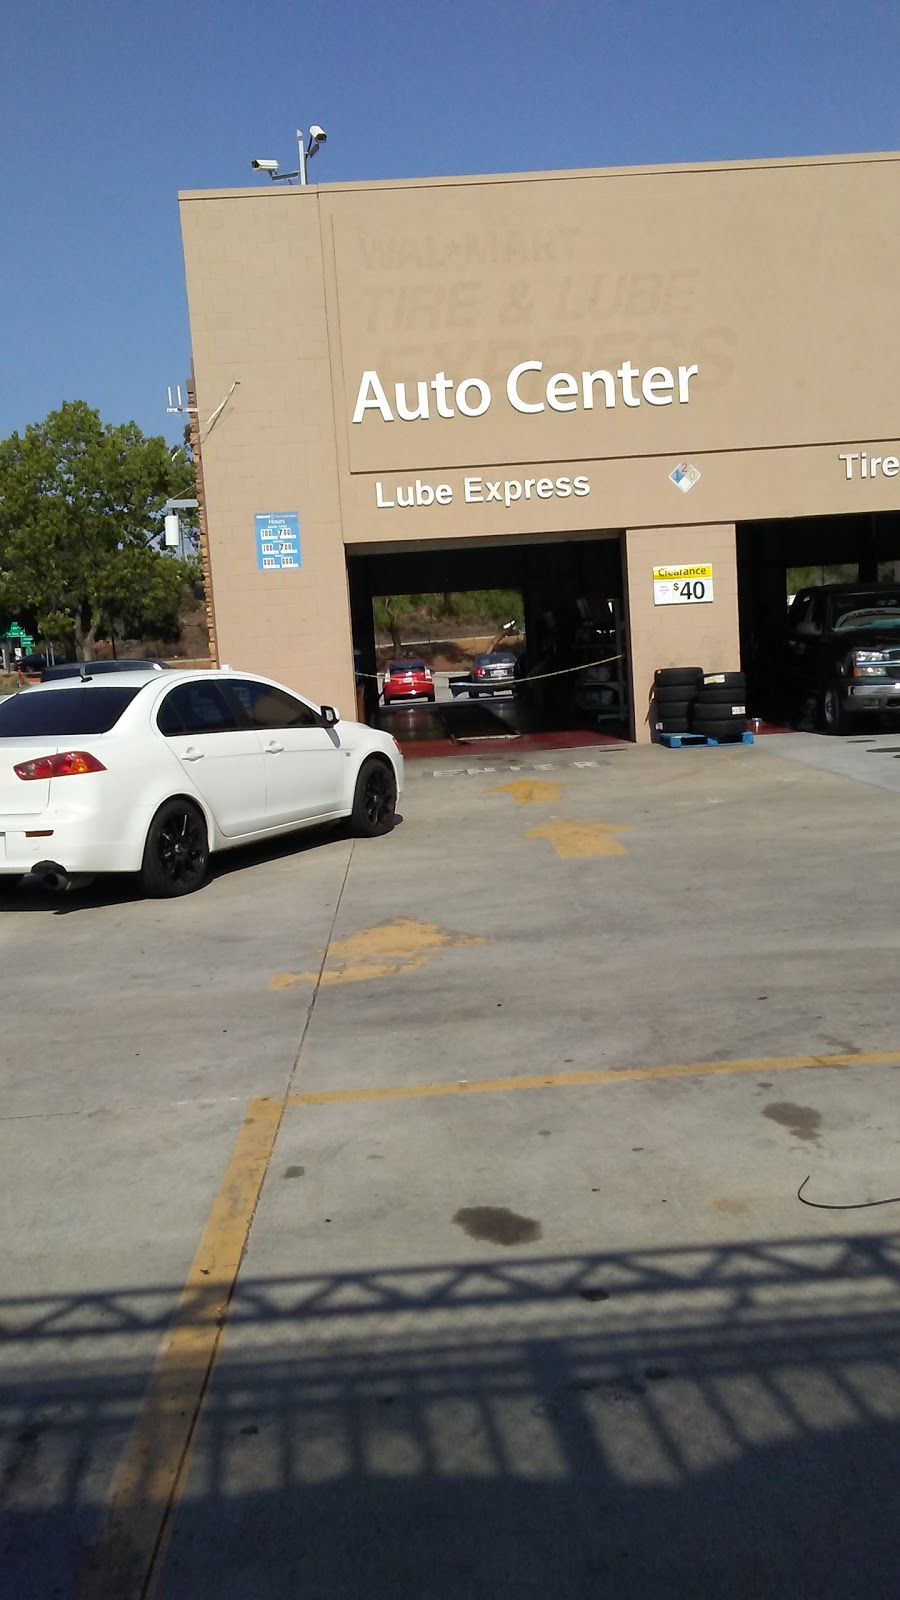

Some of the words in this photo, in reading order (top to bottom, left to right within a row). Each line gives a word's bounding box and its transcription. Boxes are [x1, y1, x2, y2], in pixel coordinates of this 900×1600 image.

[360, 281, 484, 333] TIRE
[497, 278, 535, 326] &
[553, 267, 701, 322] LUBE
[352, 370, 492, 424] Auto
[506, 360, 699, 414] Center
[681, 463, 688, 473] 2
[838, 452, 900, 480] Tire
[375, 479, 454, 509] Lube
[463, 475, 591, 509] Express
[658, 566, 707, 577] Clearance
[673, 581, 706, 600] $40
